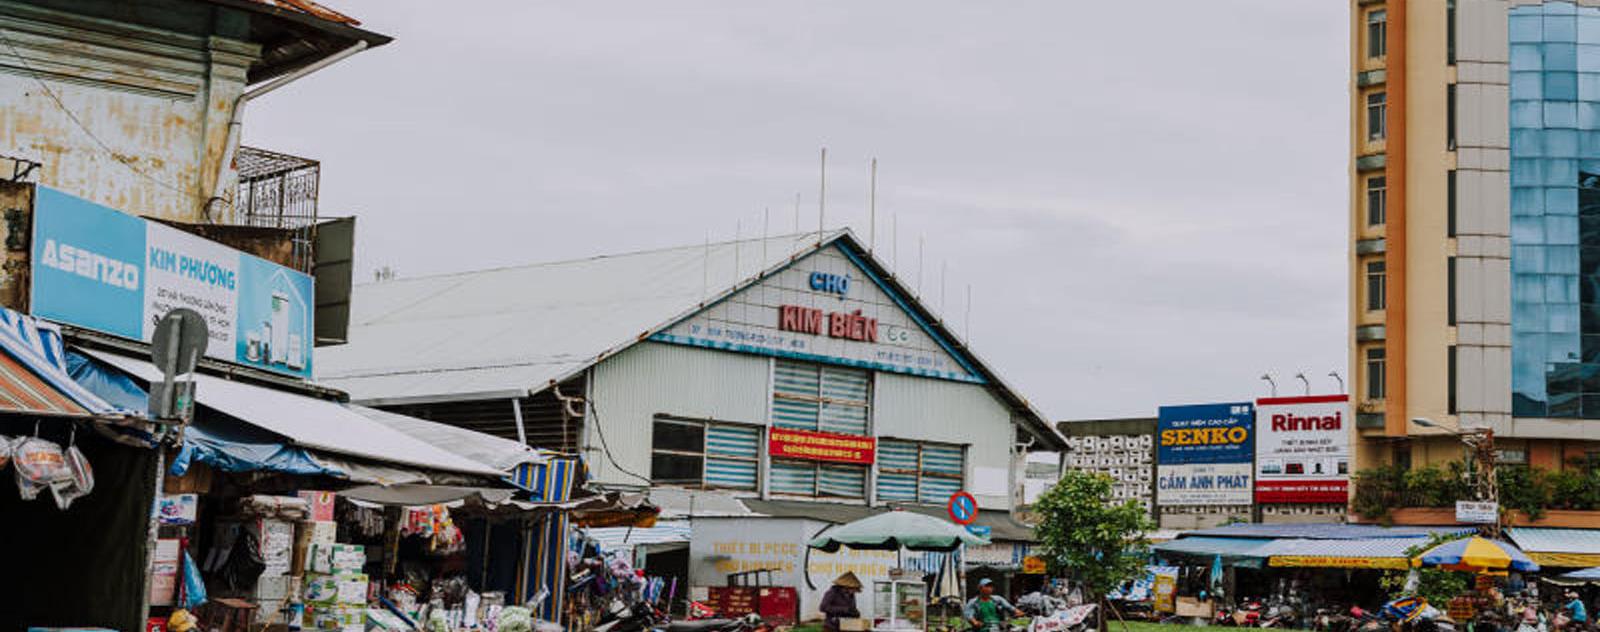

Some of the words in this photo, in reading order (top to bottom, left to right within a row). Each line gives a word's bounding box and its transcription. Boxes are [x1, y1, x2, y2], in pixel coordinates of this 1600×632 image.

[150, 247, 176, 273] KIM
[180, 255, 235, 290] PHƯƠNG
[809, 271, 852, 301] CHỢ
[779, 304, 823, 336] KIM
[1272, 411, 1342, 432] Rinnai
[1161, 426, 1248, 446] SENKO
[1189, 475, 1214, 489] ANH
